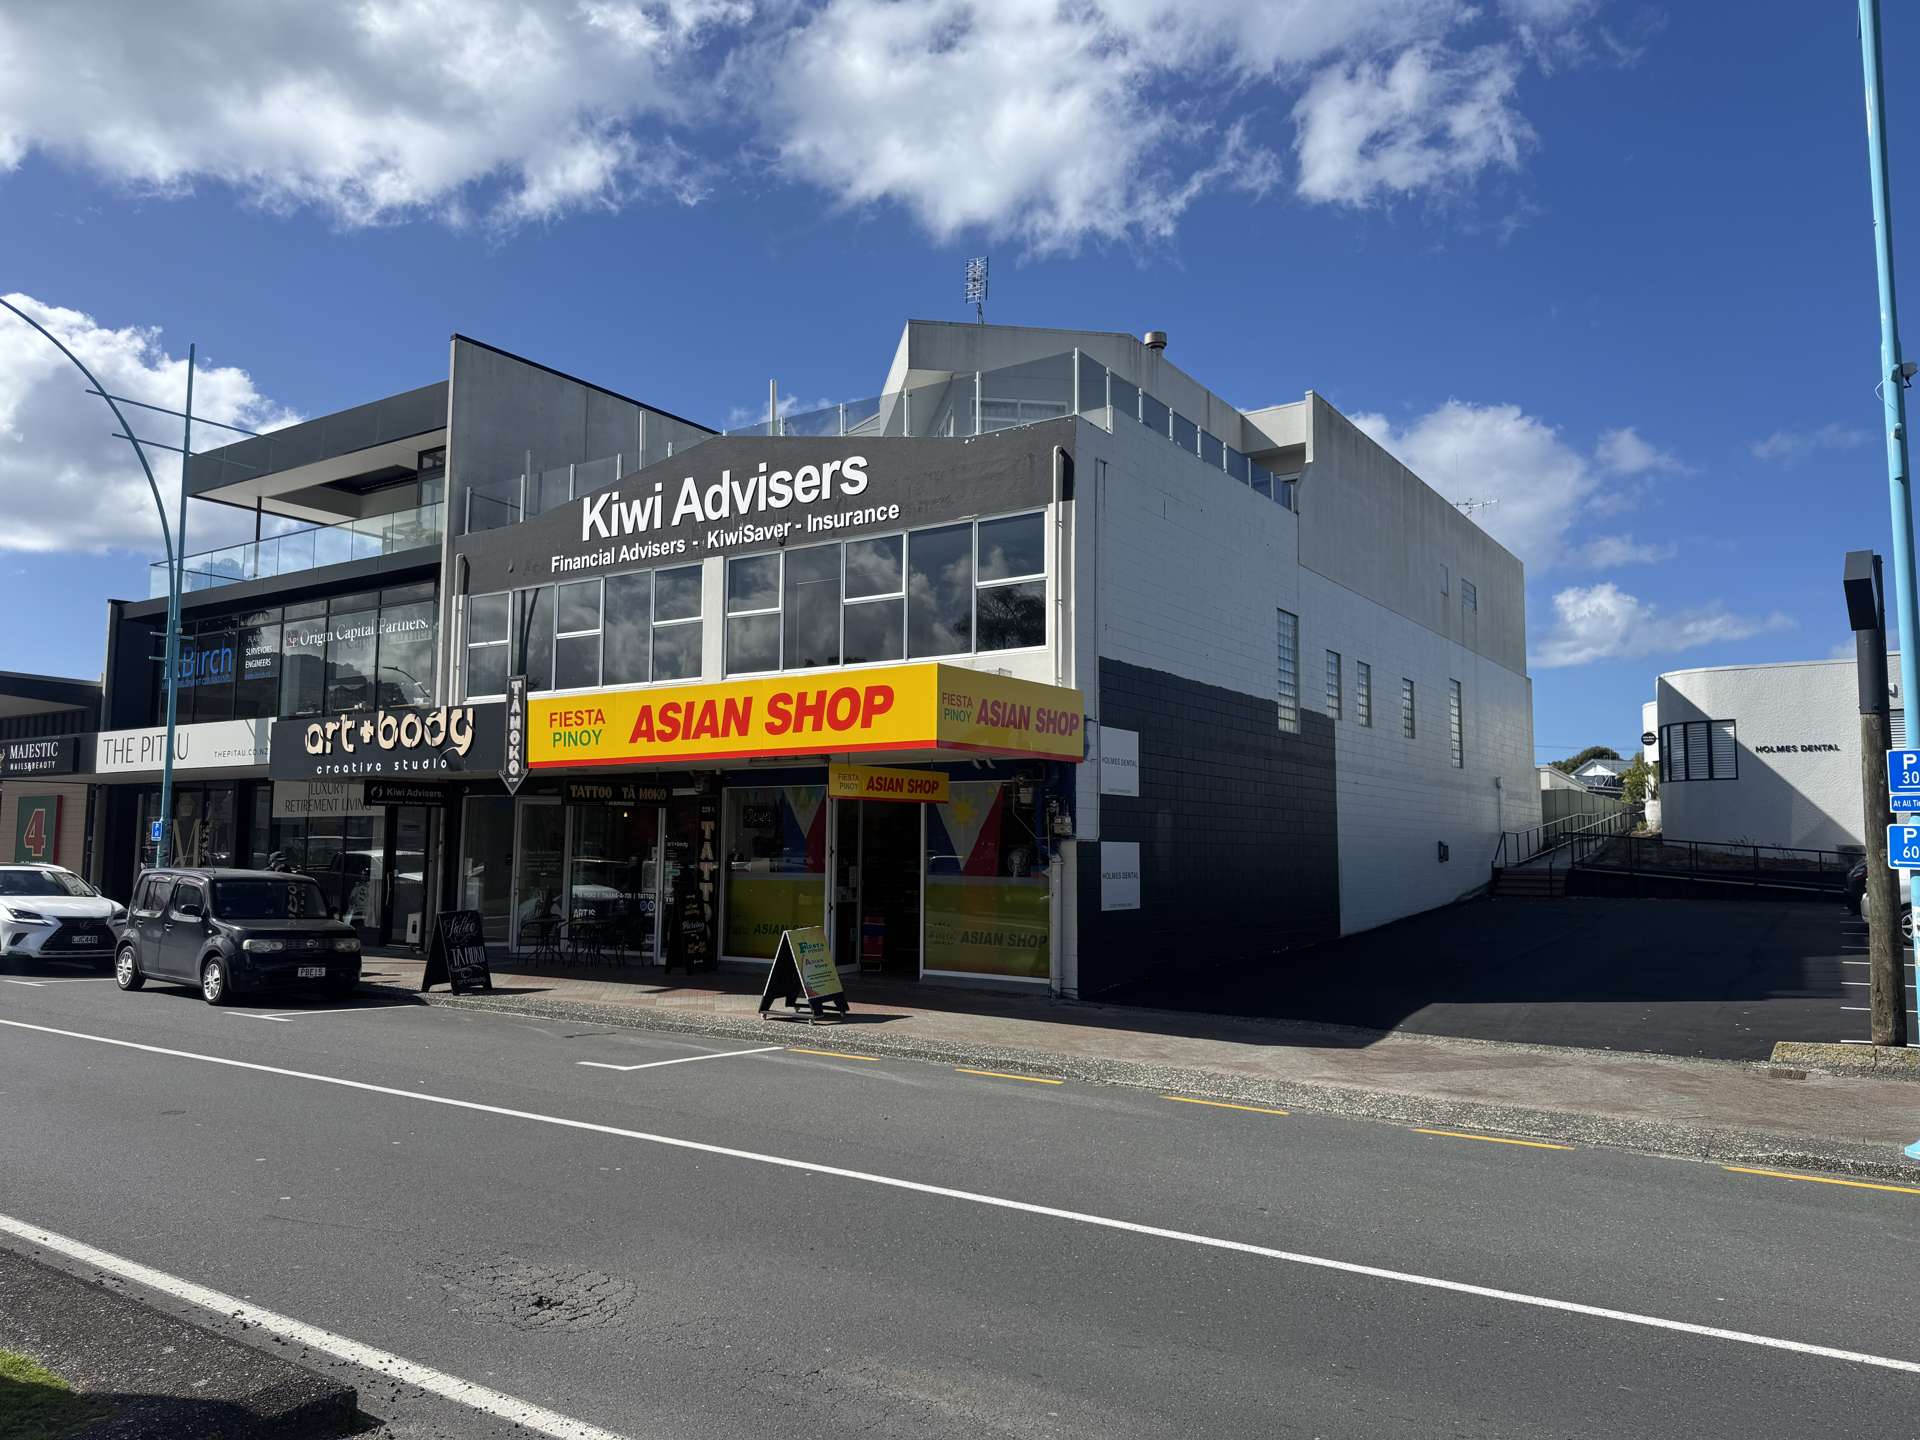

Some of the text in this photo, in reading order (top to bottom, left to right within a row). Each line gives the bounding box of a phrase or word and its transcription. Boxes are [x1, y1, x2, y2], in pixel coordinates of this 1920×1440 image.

[582, 455, 869, 542] Kiwi Advisers
[551, 551, 615, 573] Financial
[618, 539, 686, 563] Advisers
[707, 520, 791, 549] KiwiSaver
[807, 506, 900, 533] Insurance
[942, 692, 973, 709] FIESTA
[549, 707, 606, 728] FIESTA
[629, 684, 895, 744] ASIAN SHOP
[944, 708, 972, 723] PINOY
[976, 698, 1080, 736] ASIAN SHOP
[552, 729, 602, 748] PINOY
[9, 741, 58, 759] MAJESTIC
[103, 732, 189, 765] THE PITU
[1755, 744, 1840, 753] HOLMES DENTAL
[316, 758, 447, 775] creative studio
[1903, 753, 1917, 770] P
[838, 773, 859, 782] FIESTA
[866, 775, 940, 794] ASIAN SHOP
[1902, 771, 1919, 784] 30
[310, 782, 345, 795] LUXURY
[570, 784, 612, 799] TATTOO
[639, 787, 667, 800] MOKO
[839, 782, 858, 791] PINOY
[285, 798, 340, 813] RETIREMENT
[1893, 800, 1901, 808] At
[1902, 799, 1912, 808] All
[24, 808, 46, 856] 4
[1903, 827, 1917, 844] P
[1902, 846, 1919, 859] 60
[960, 931, 1002, 945] ASIAN
[1007, 934, 1047, 948] SHOP
